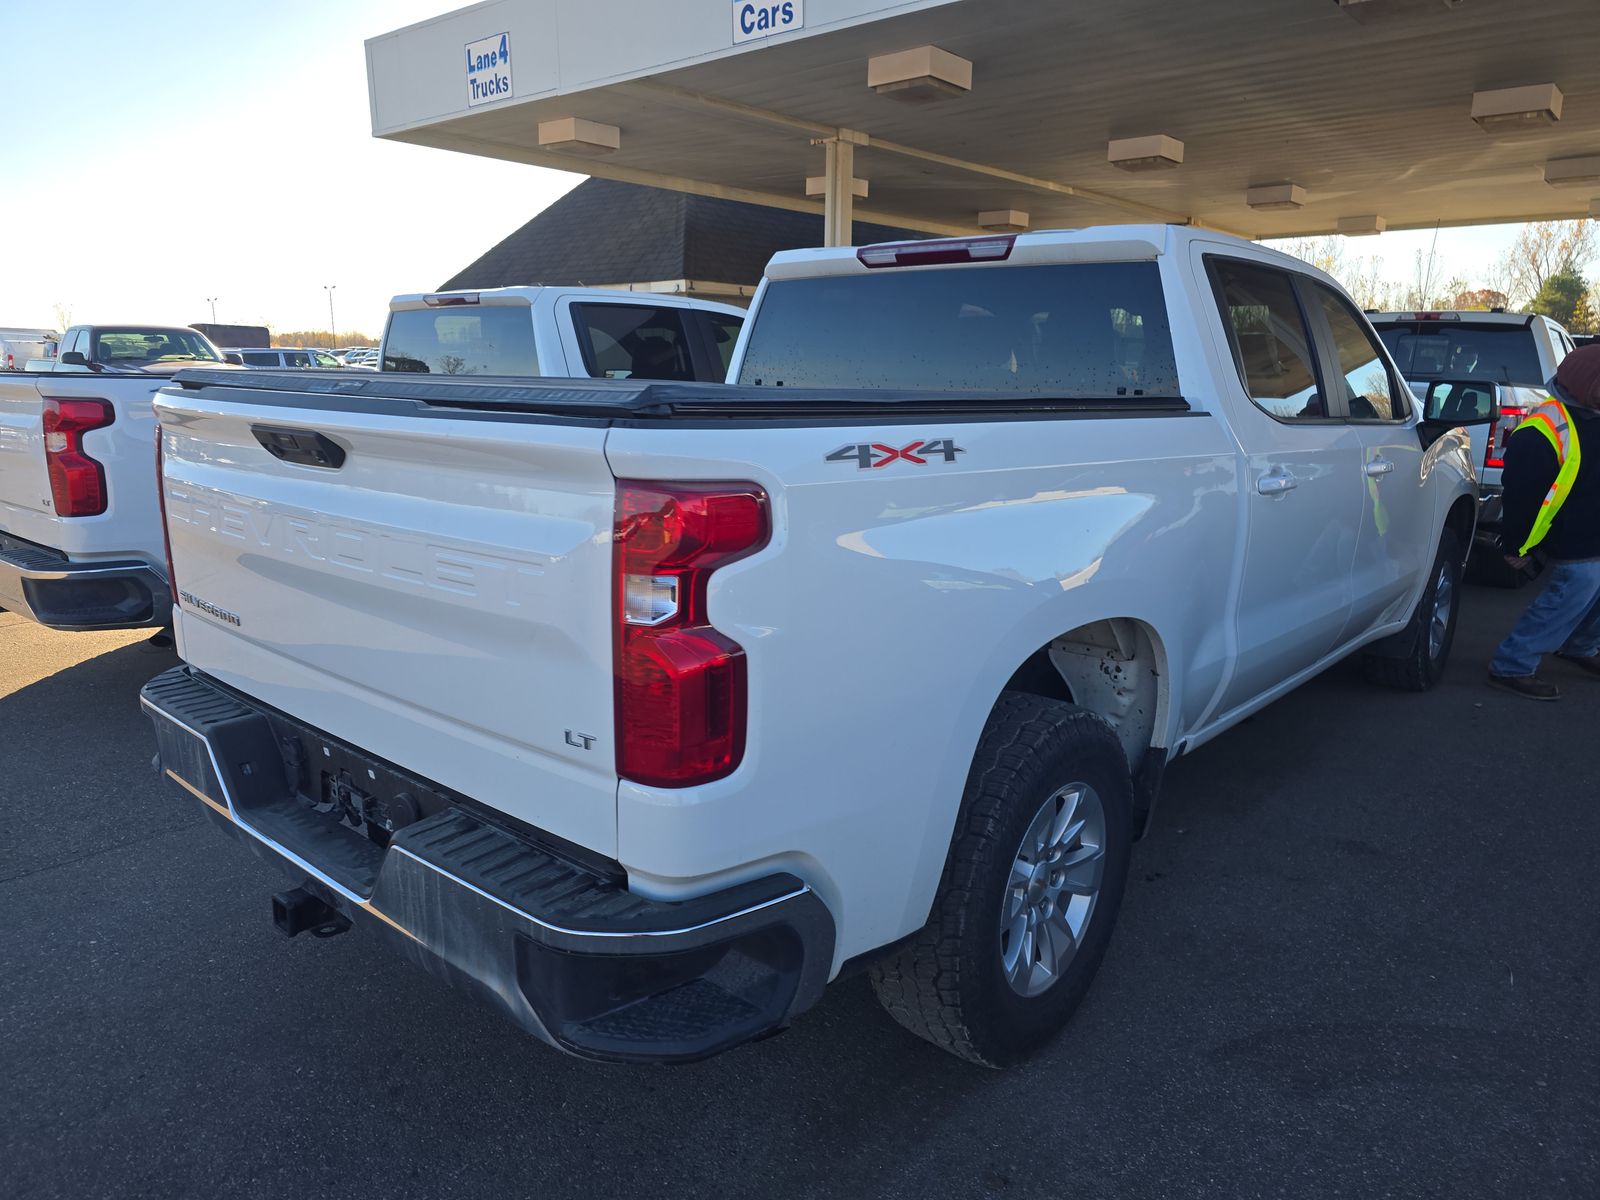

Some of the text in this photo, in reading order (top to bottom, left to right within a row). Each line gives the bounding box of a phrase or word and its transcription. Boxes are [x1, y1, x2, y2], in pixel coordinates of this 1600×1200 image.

[740, 1, 794, 35] Cars
[467, 34, 509, 74] Lane 4
[469, 72, 510, 100] Trucks
[168, 488, 546, 608] CHEVROLET
[564, 729, 597, 750] LT
